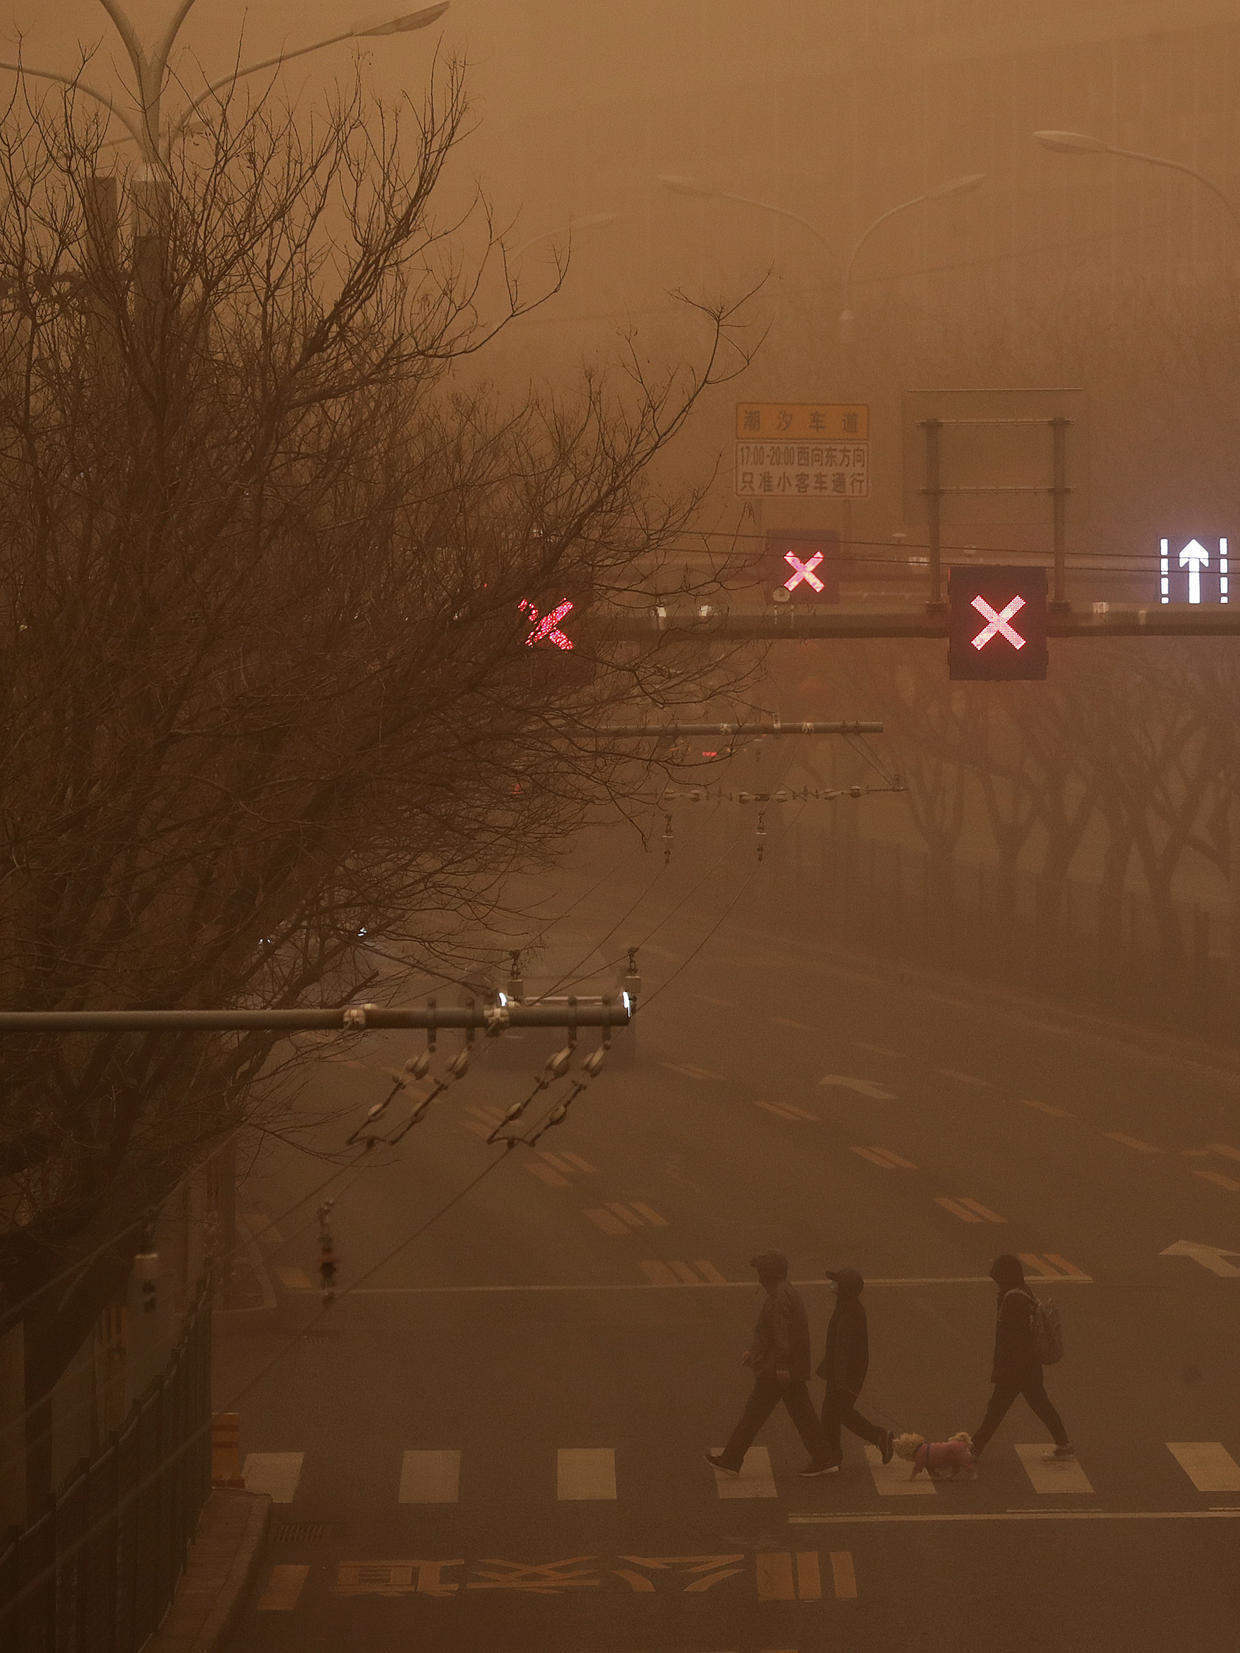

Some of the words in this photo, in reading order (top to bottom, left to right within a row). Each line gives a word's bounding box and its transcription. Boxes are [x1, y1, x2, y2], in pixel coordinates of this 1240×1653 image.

[743, 409, 859, 433] 潮汐车道
[740, 471, 866, 494] 只准小客车通行
[328, 1553, 747, 1597] 公交道
